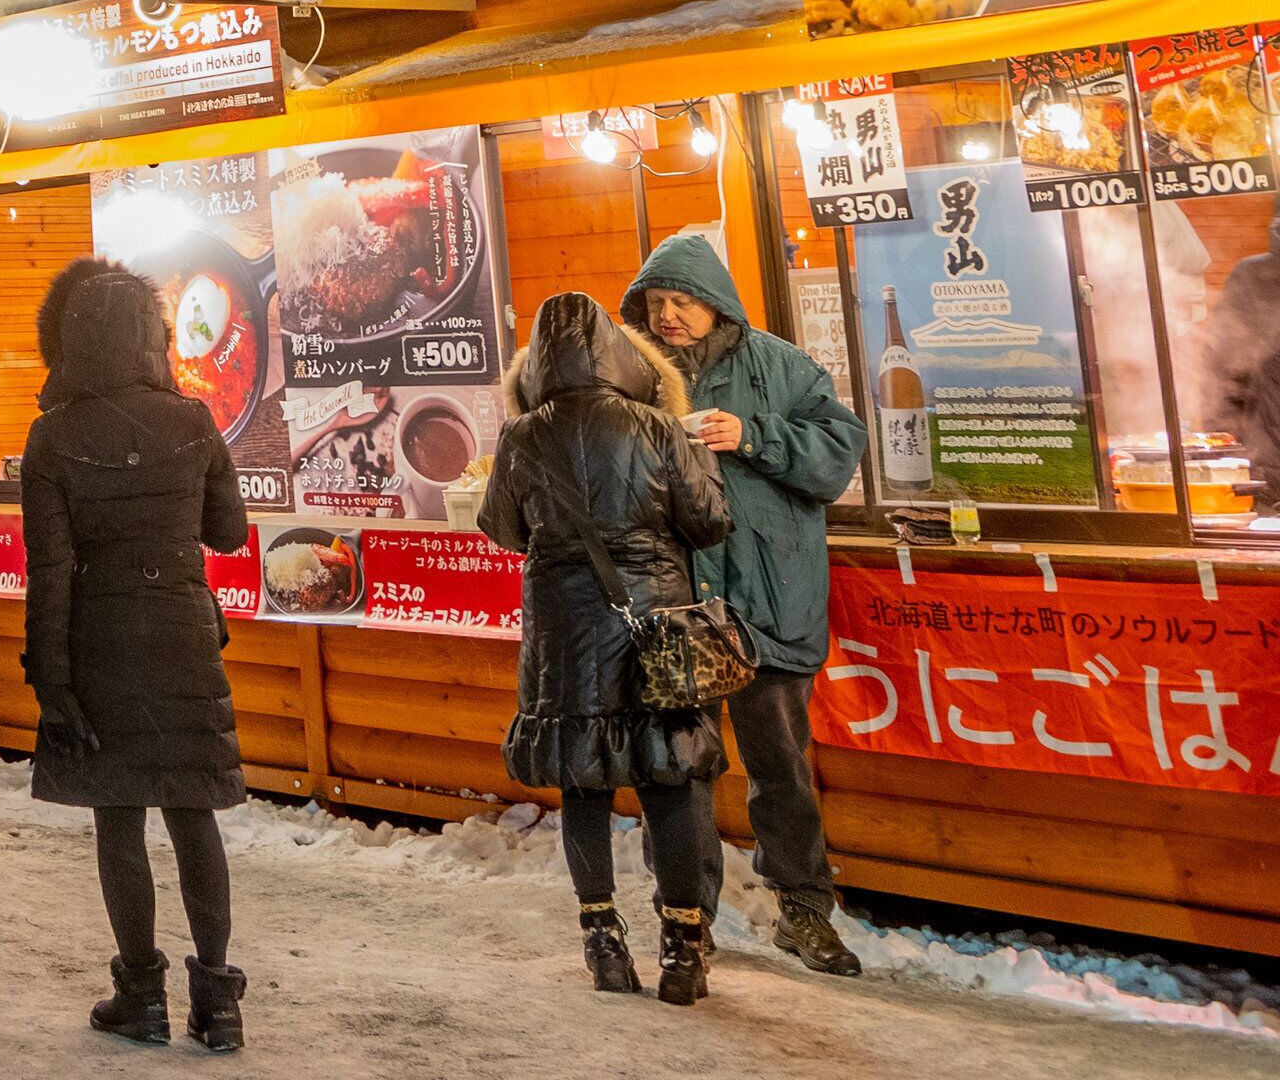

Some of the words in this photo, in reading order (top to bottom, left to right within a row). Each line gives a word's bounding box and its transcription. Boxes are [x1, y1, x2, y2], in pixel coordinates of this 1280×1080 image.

[137, 62, 188, 82] produced
[191, 60, 202, 72] in
[206, 51, 261, 70] Hokkaido
[1149, 70, 1175, 83] grilled
[1180, 63, 1205, 74] spiral
[1207, 53, 1242, 67] shellfish
[119, 113, 130, 121] THE
[147, 108, 165, 118] SMITH
[855, 108, 884, 183] 男山
[1155, 182, 1188, 194] 3pcs
[836, 193, 908, 223] 350円
[458, 173, 476, 266] じっくり煮込んで
[940, 180, 985, 277] 男山
[799, 286, 820, 297] One
[934, 285, 1006, 296] OTOKOYAMA
[936, 303, 1009, 313] 北の大地が造る酒
[291, 334, 335, 356] 粉雪の
[412, 340, 473, 367] ¥500
[293, 357, 391, 379] 煮込ハンバーグ
[299, 457, 344, 470] スミスの
[300, 474, 403, 490] ホットチョコミルク
[372, 582, 425, 603] スミスの
[369, 606, 489, 629] ホットチョコミルク
[825, 636, 1280, 776] うにごは
